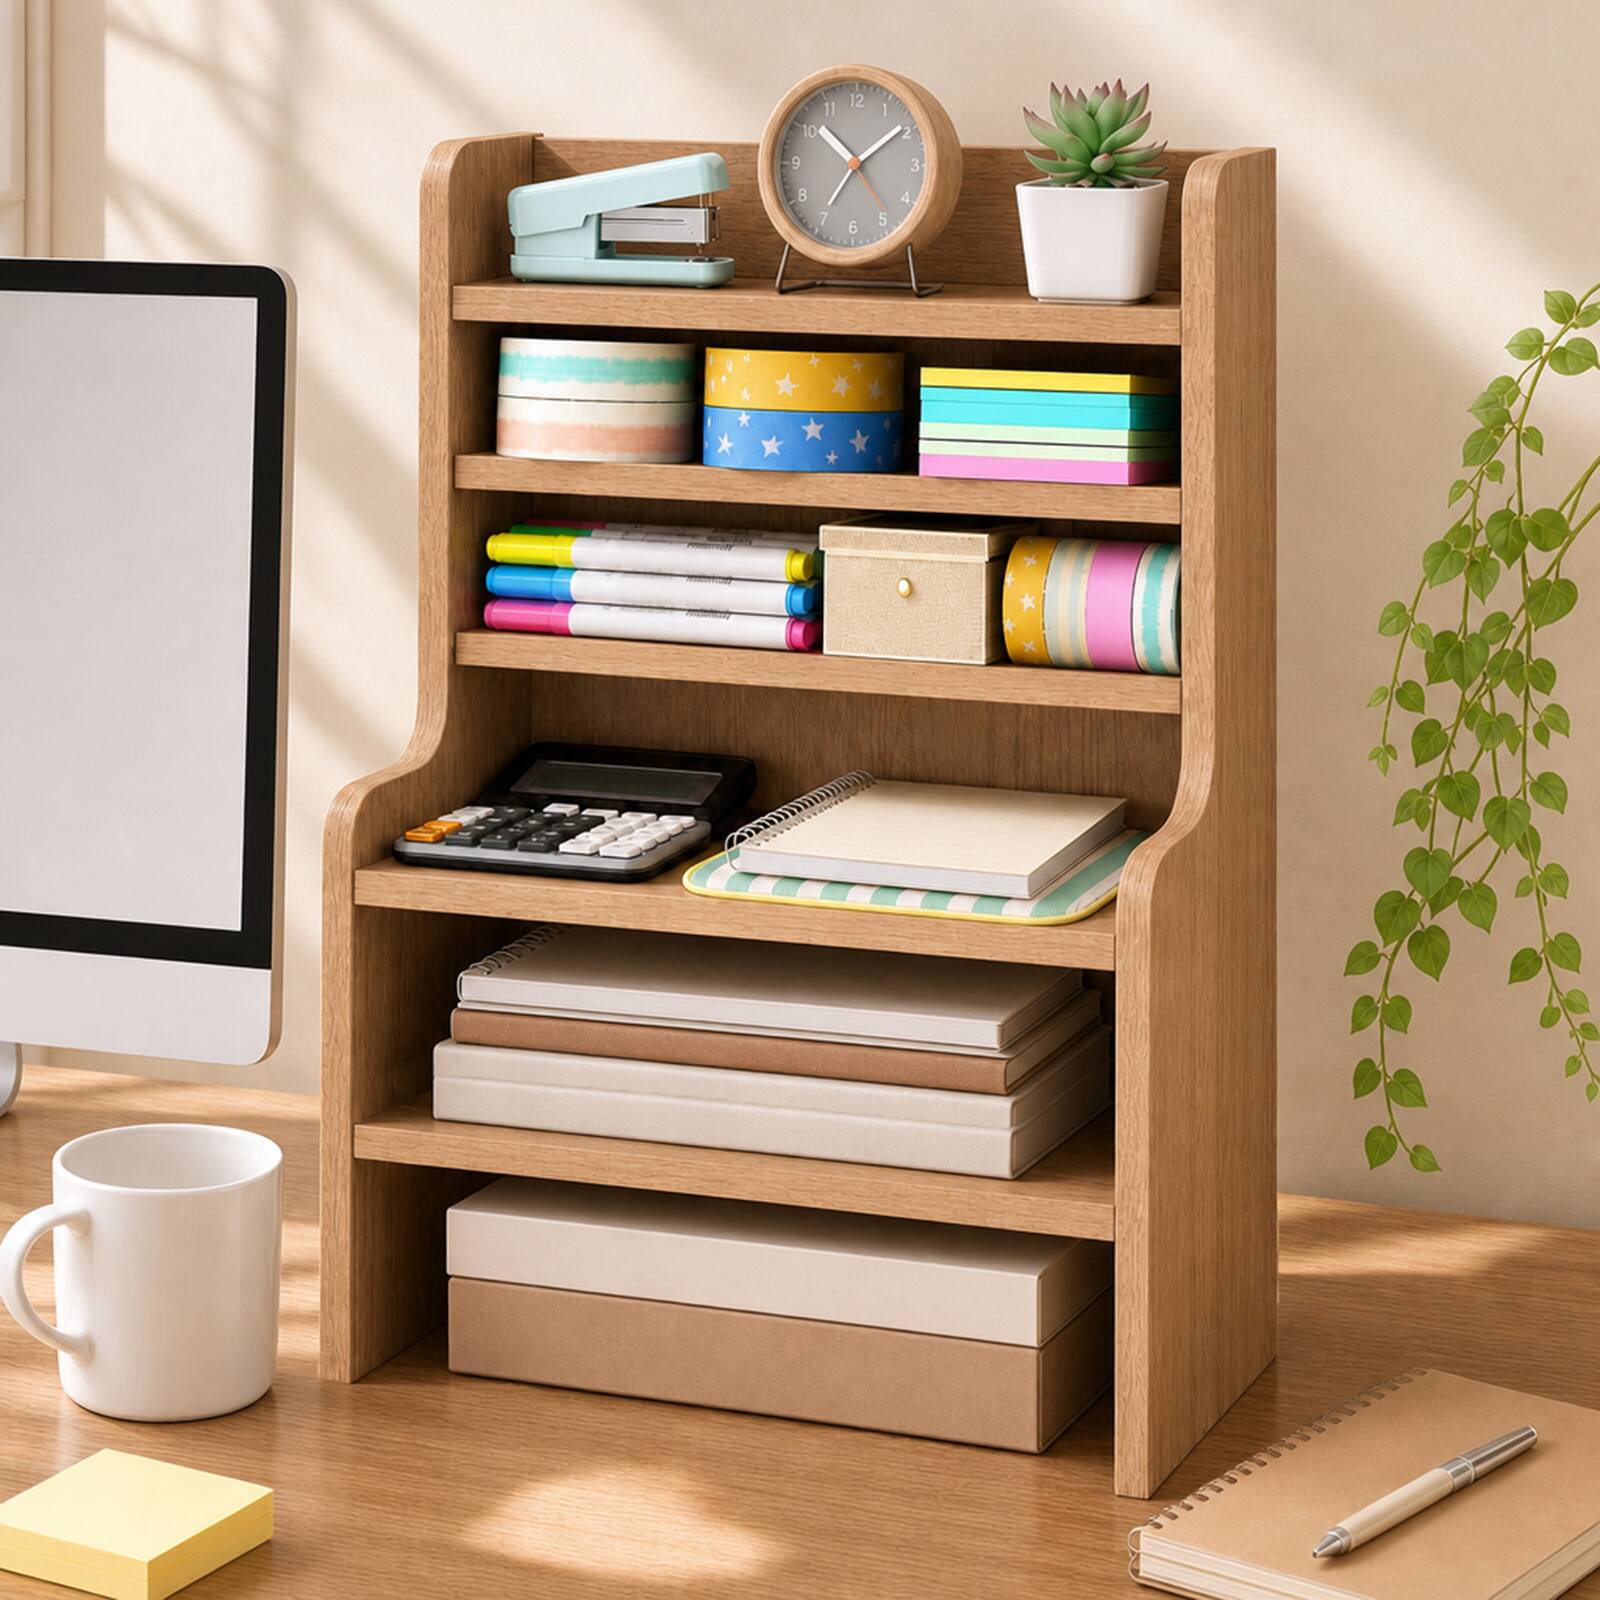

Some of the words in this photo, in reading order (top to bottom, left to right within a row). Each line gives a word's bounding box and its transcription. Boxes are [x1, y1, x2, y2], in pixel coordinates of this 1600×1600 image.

[850, 93, 864, 108] 12
[824, 102, 836, 117] 11
[882, 103, 887, 117] 1
[802, 124, 817, 138] 10
[901, 126, 911, 140] 2
[791, 156, 801, 170] 9
[910, 158, 920, 172] 3
[798, 188, 807, 202] 8
[901, 190, 910, 204] 4
[820, 211, 829, 226] 7
[878, 212, 887, 227] 5
[848, 220, 858, 234] 6
